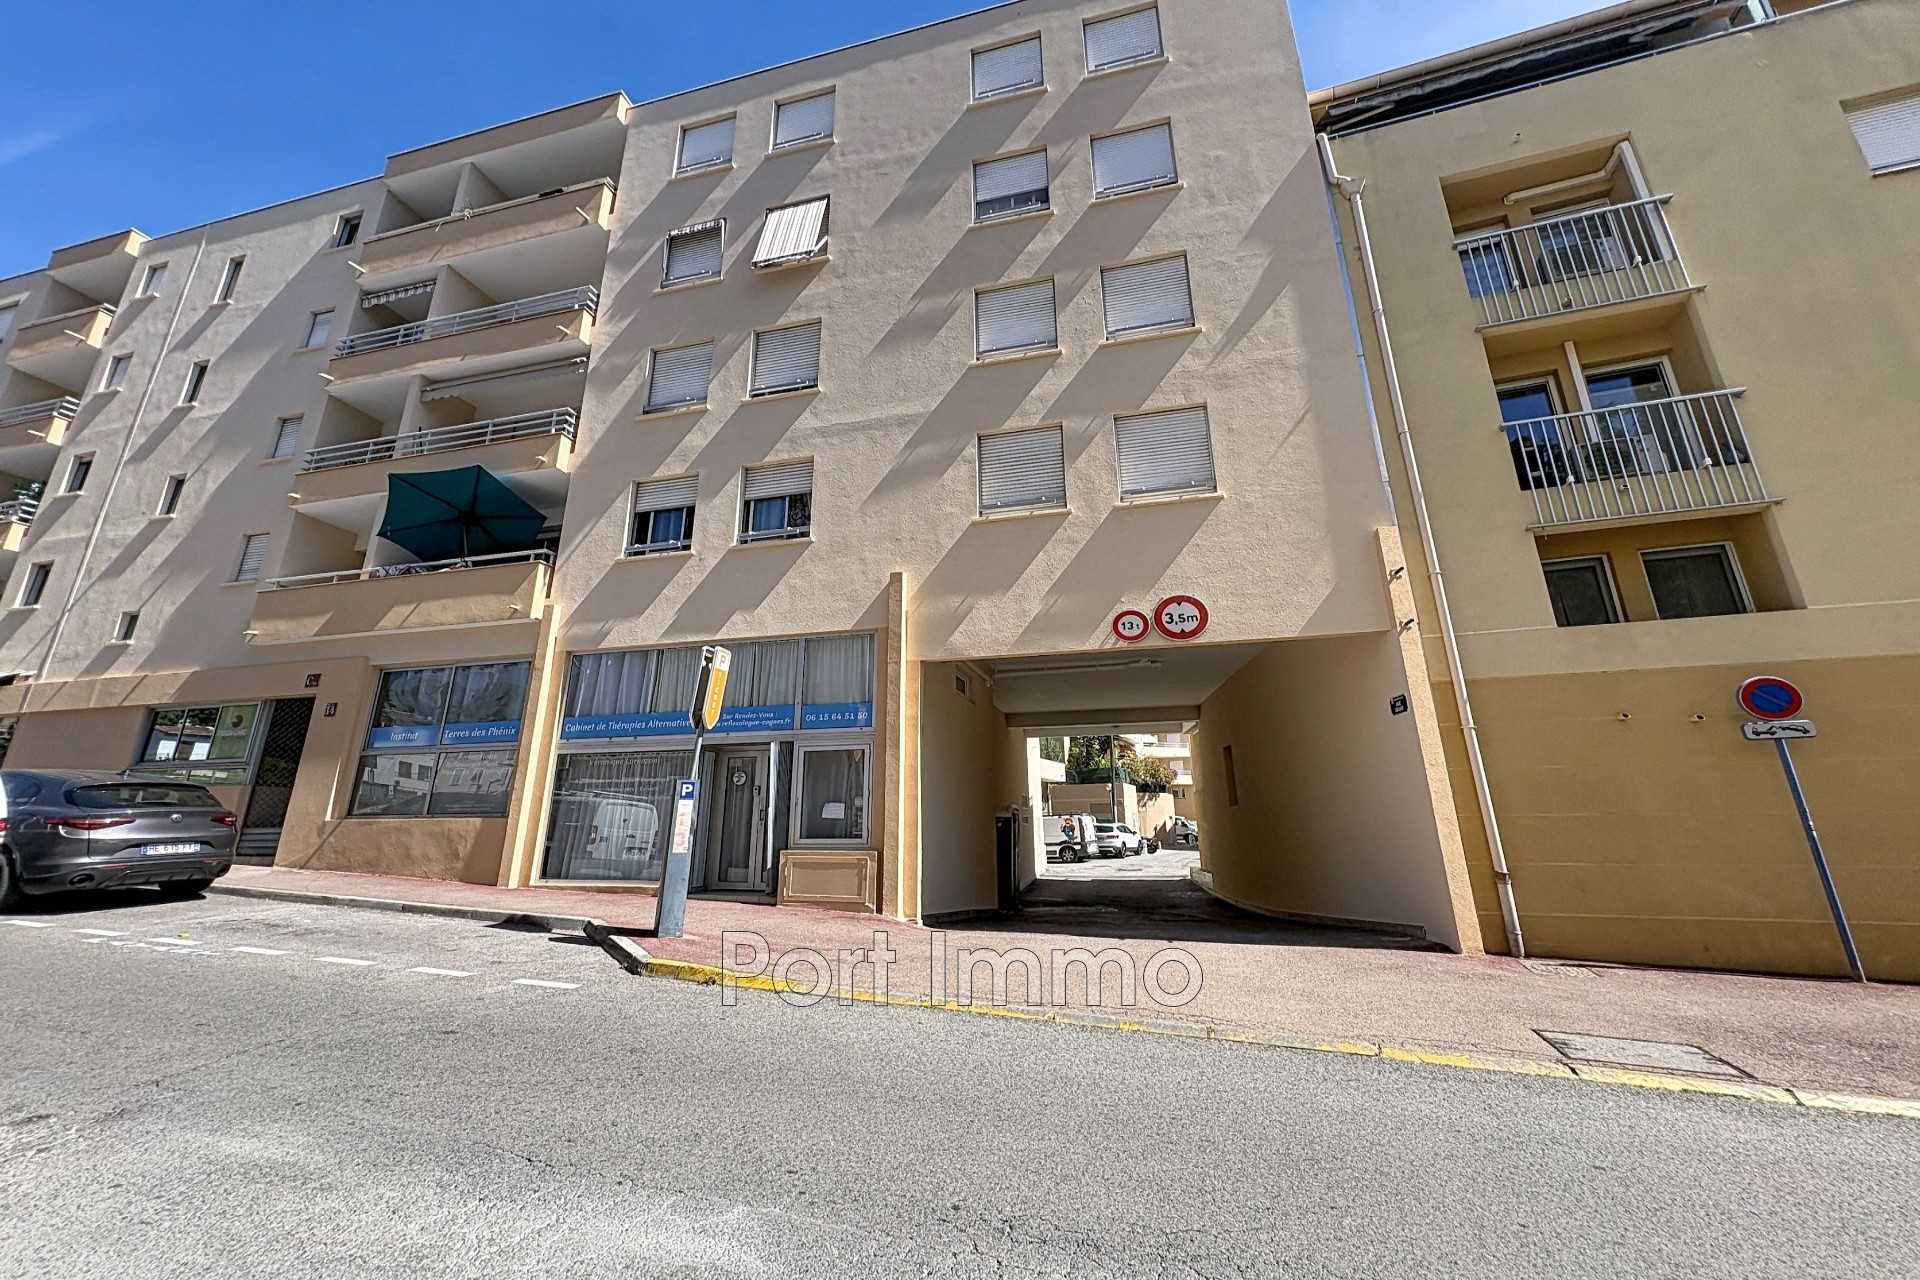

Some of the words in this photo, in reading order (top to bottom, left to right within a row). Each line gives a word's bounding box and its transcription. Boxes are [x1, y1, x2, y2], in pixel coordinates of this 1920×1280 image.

[1164, 612, 1199, 626] 3,5m
[1120, 621, 1134, 631] 13
[719, 654, 727, 664] P
[711, 671, 723, 716] TICKET
[734, 711, 774, 719] Rendez-Vous
[819, 713, 829, 721] 15
[831, 712, 842, 720] 64
[844, 712, 855, 720] 51
[857, 711, 868, 719] 50
[565, 722, 595, 733] Cabinet
[596, 721, 606, 731] de
[608, 720, 646, 732] Thérapies
[647, 718, 691, 729] Alternative
[390, 732, 419, 741] Institut
[444, 729, 470, 739] Terres
[471, 728, 486, 737] des
[488, 727, 516, 736] Phénix
[681, 783, 694, 797] P
